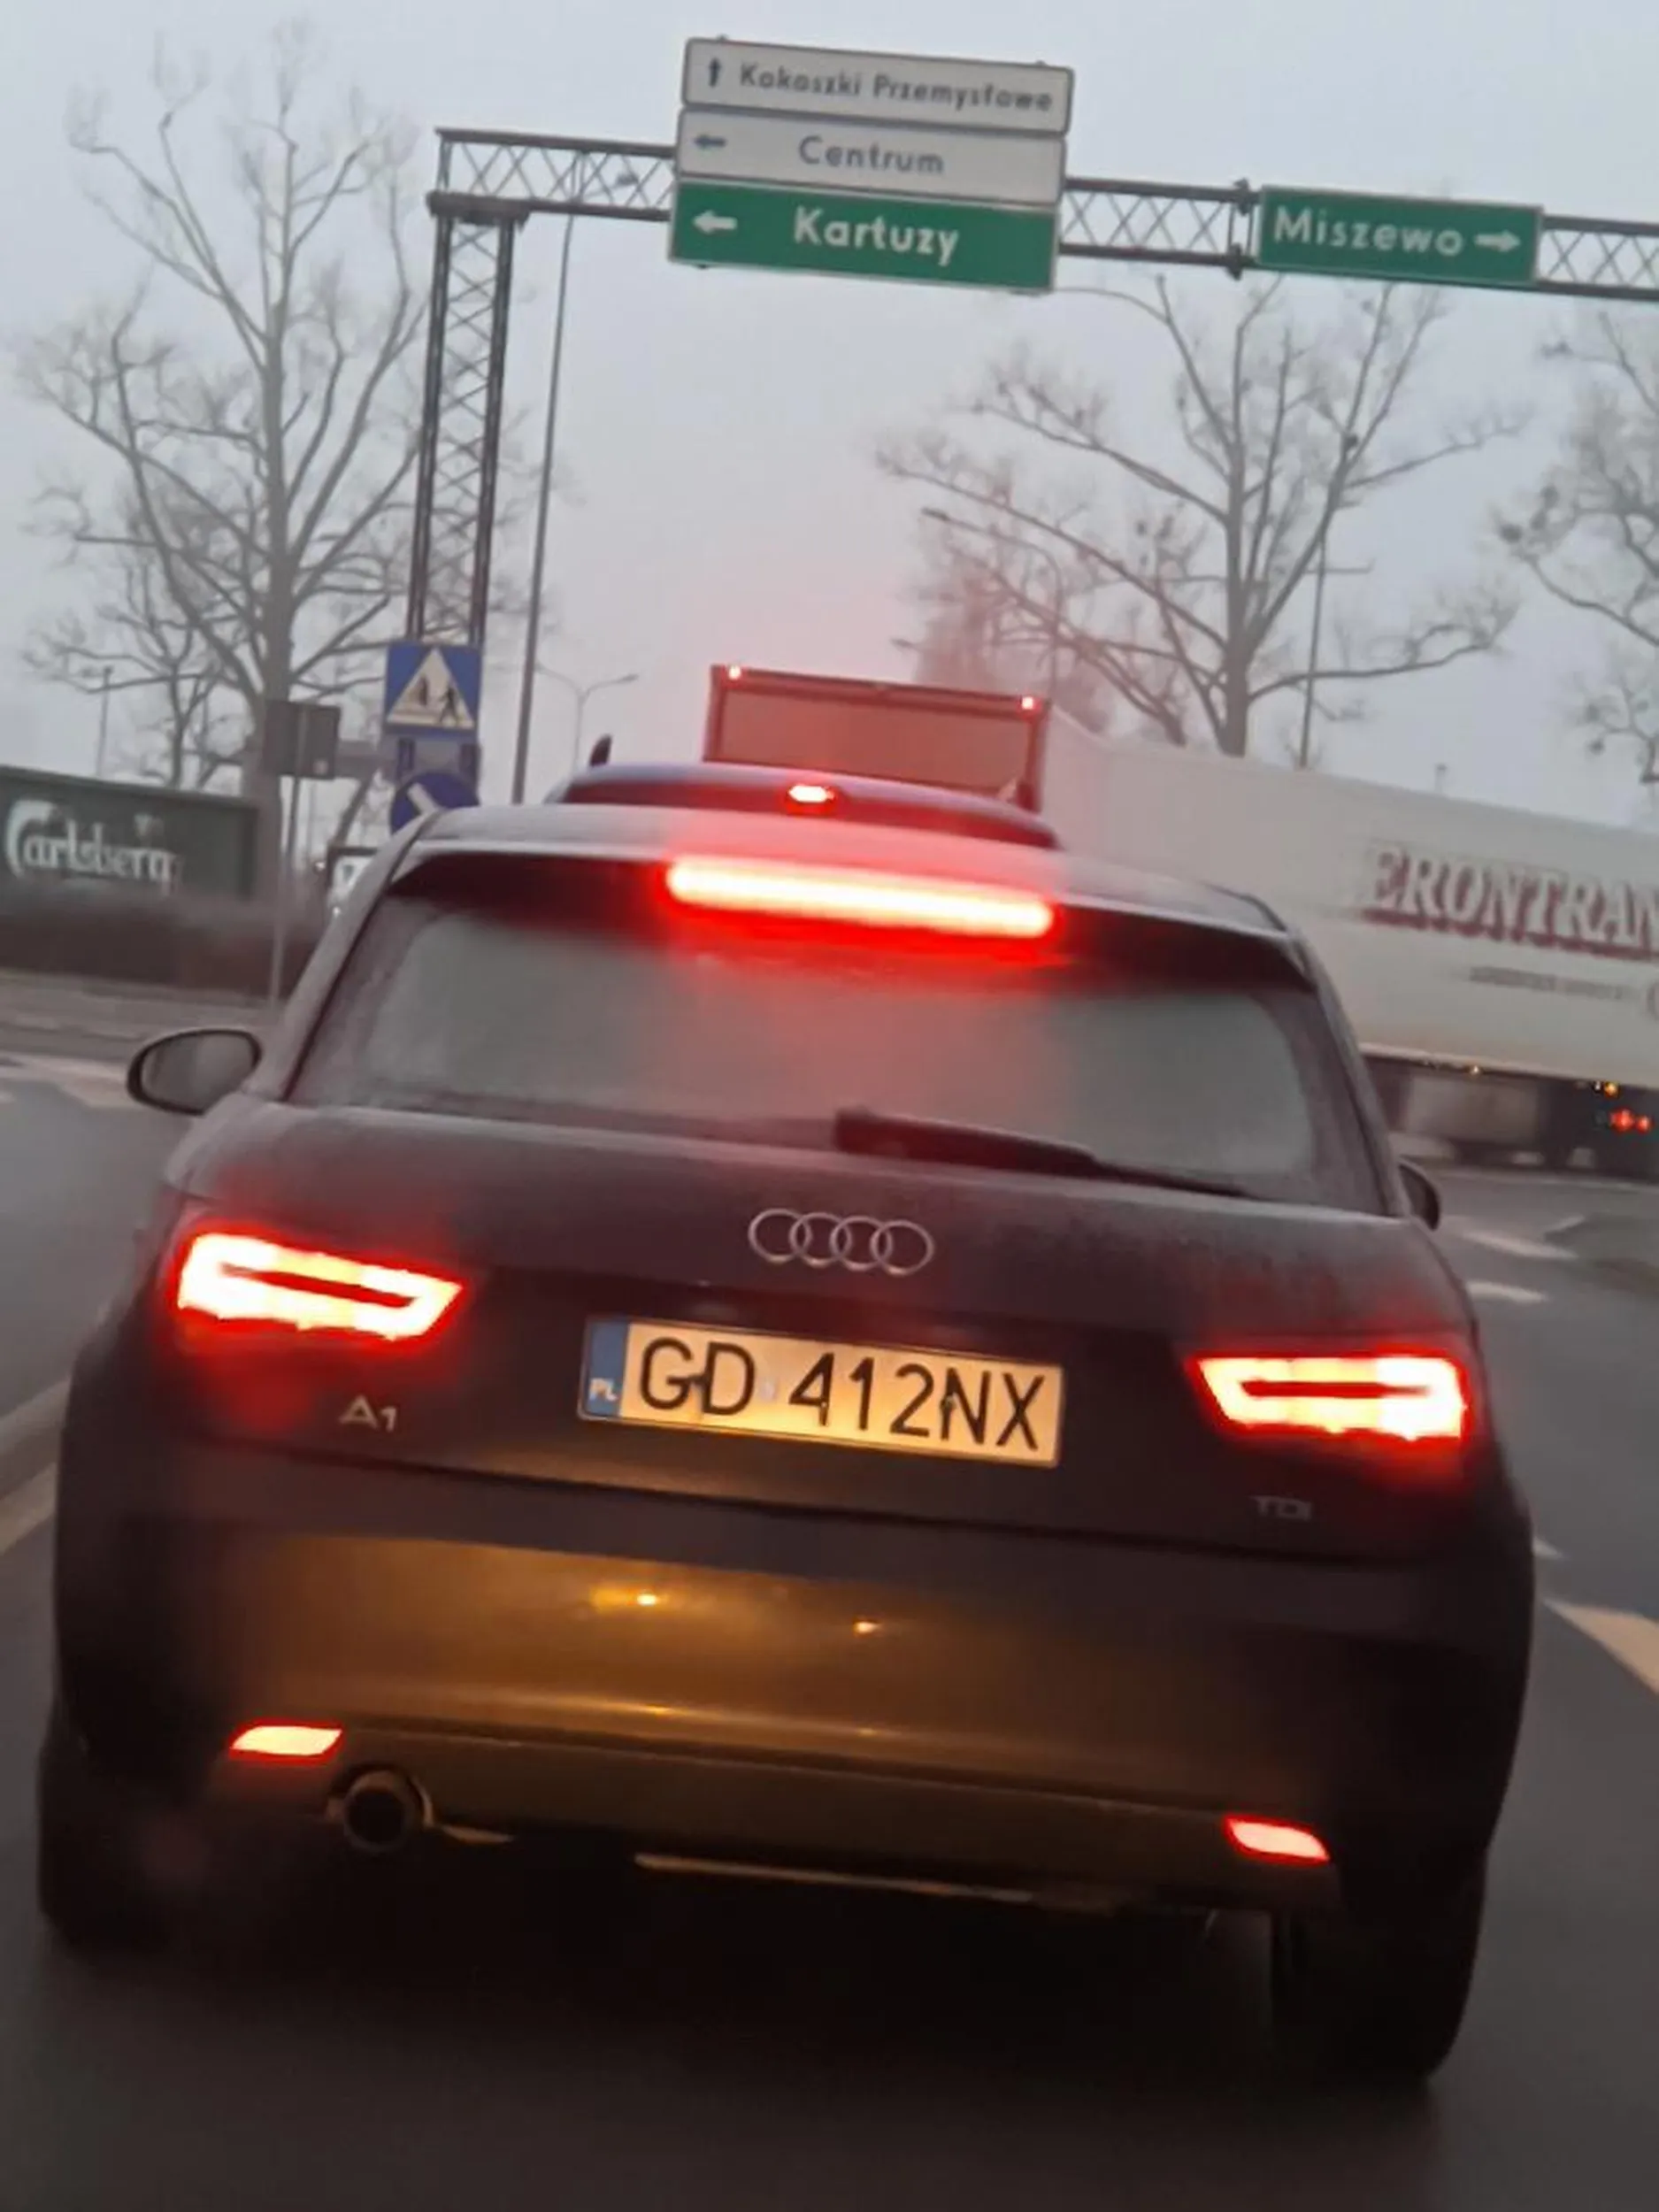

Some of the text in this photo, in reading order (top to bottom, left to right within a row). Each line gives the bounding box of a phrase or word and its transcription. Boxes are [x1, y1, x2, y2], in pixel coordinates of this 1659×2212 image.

[739, 62, 862, 97] Kokoszki
[798, 134, 945, 174] Centrum
[794, 205, 960, 266] Kartuzy
[1273, 204, 1465, 257] Miszewo
[338, 1394, 397, 1432] A1
[640, 1337, 1045, 1452] GD 412NX
